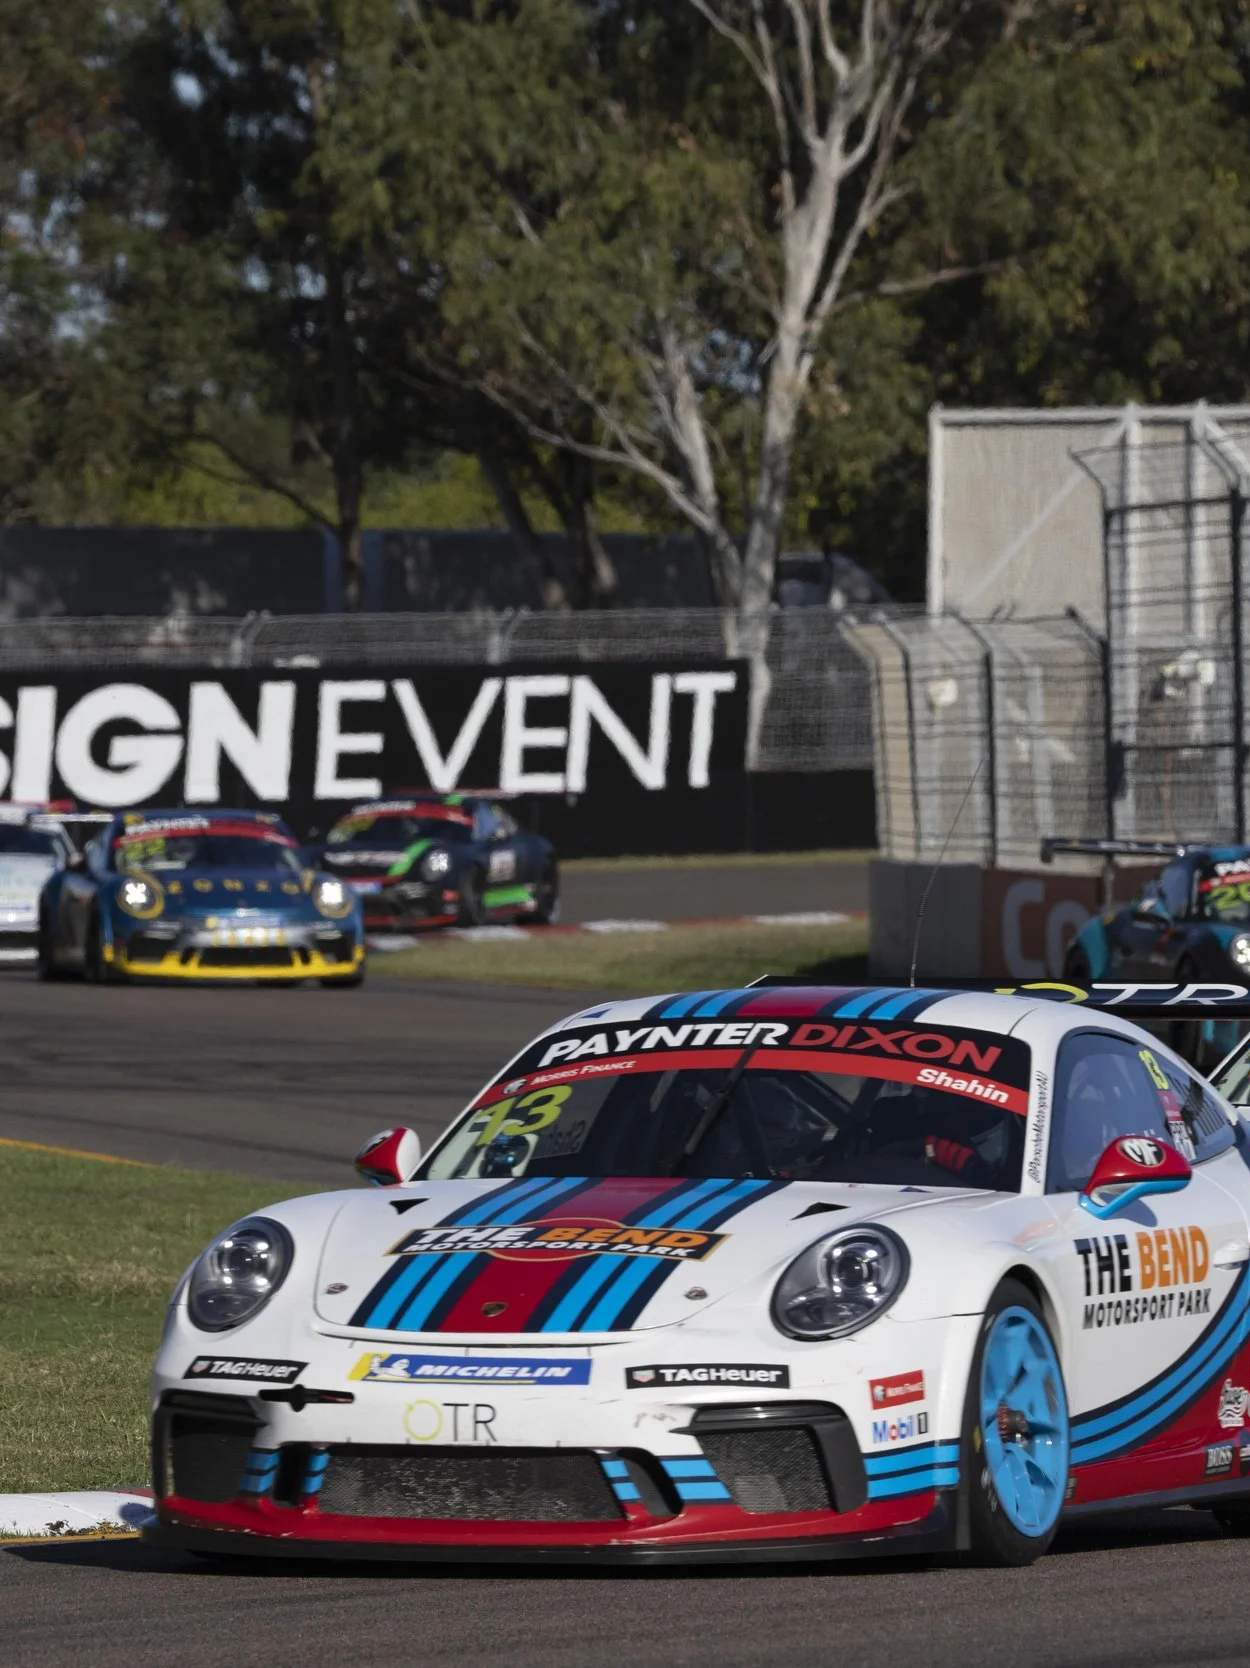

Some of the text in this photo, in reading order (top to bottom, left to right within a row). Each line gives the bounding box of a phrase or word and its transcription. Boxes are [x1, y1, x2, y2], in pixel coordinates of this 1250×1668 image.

[0, 681, 296, 807] IGN
[537, 1022, 1002, 1072] PAYNTER DIXON
[578, 1059, 637, 1075] FINANCE
[916, 1068, 1009, 1104] Shahin
[475, 1084, 573, 1146] 13
[402, 1240, 697, 1258] MOTORSPORT PARK
[418, 1226, 710, 1248] THE BEND
[1073, 1225, 1210, 1297] THE BEND
[1082, 1287, 1212, 1330] MOTORSPORT PARK
[414, 1363, 573, 1378] MICHELIN
[403, 1399, 498, 1443] OTR
[872, 1414, 913, 1444] Mobil
